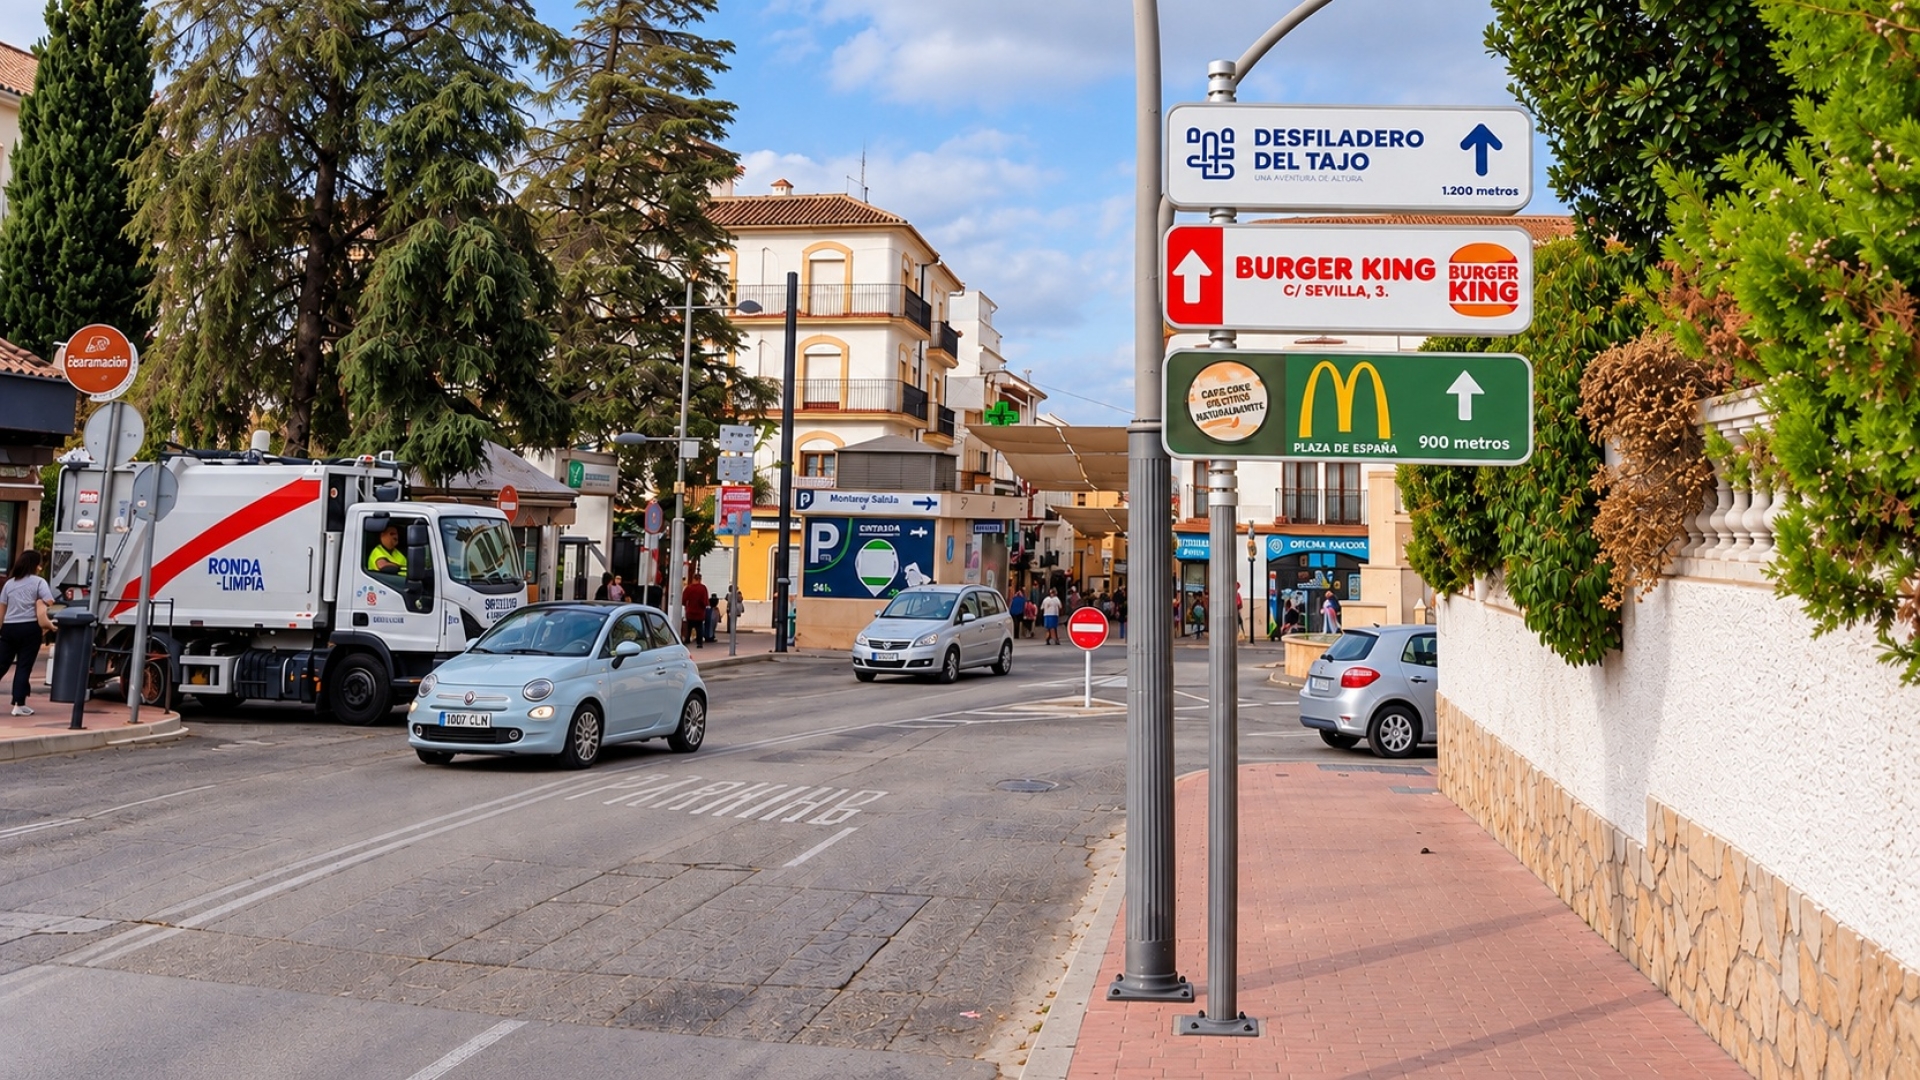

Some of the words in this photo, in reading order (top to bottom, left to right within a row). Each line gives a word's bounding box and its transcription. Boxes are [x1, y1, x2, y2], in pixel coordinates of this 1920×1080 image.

[1254, 128, 1425, 148] DESFILADERO
[1254, 152, 1300, 170] DEL
[1305, 152, 1370, 171] TAJO
[1254, 174, 1272, 182] UNA
[1273, 174, 1317, 182] AVENTURA
[1331, 175, 1364, 183] ALTURA
[1441, 186, 1473, 196] 1.200
[1476, 186, 1519, 196] metros
[1236, 256, 1353, 280] BURGER
[1361, 257, 1436, 281] KING
[1449, 265, 1518, 280] BURGER
[1283, 284, 1301, 297] C/
[1305, 285, 1371, 299] SEVILLA,
[1375, 285, 1389, 297] 3.
[1449, 281, 1518, 302] KING
[1293, 442, 1331, 453] PLAZA
[1334, 443, 1349, 453] DE
[1353, 441, 1398, 454] ESPAÑA
[1418, 435, 1449, 449] 900
[1454, 436, 1510, 450] metros
[810, 522, 840, 564] P
[208, 557, 262, 576] RONDA
